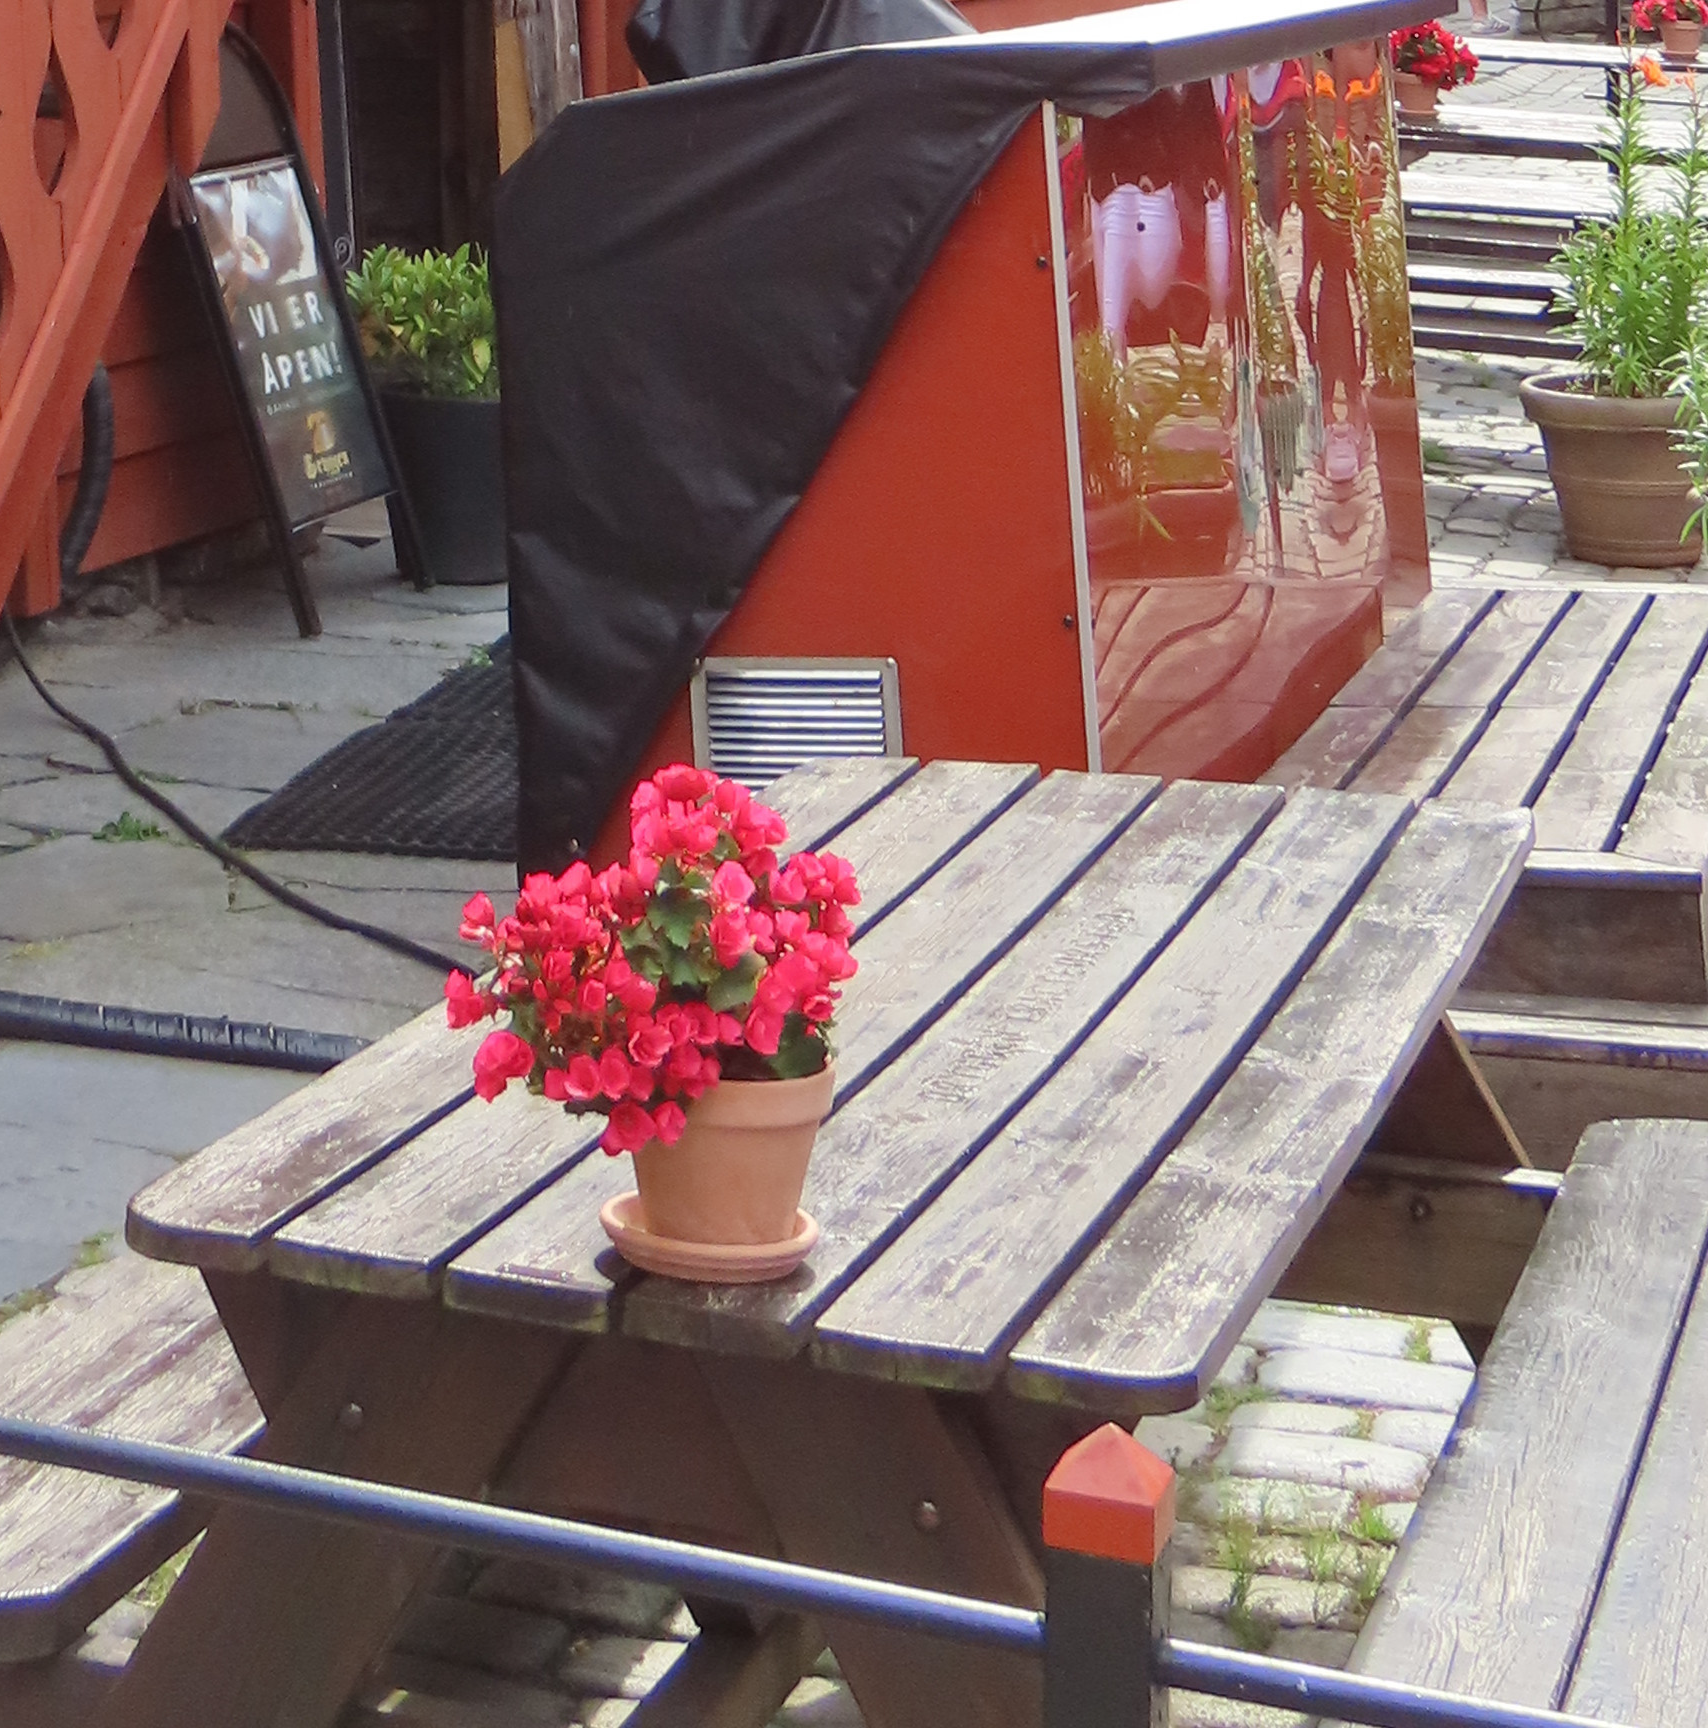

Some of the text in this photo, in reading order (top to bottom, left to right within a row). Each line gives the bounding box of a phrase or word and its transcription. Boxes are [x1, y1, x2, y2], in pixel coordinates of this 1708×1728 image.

[248, 290, 325, 339] VI ER
[261, 340, 343, 395] ÅPEN!
